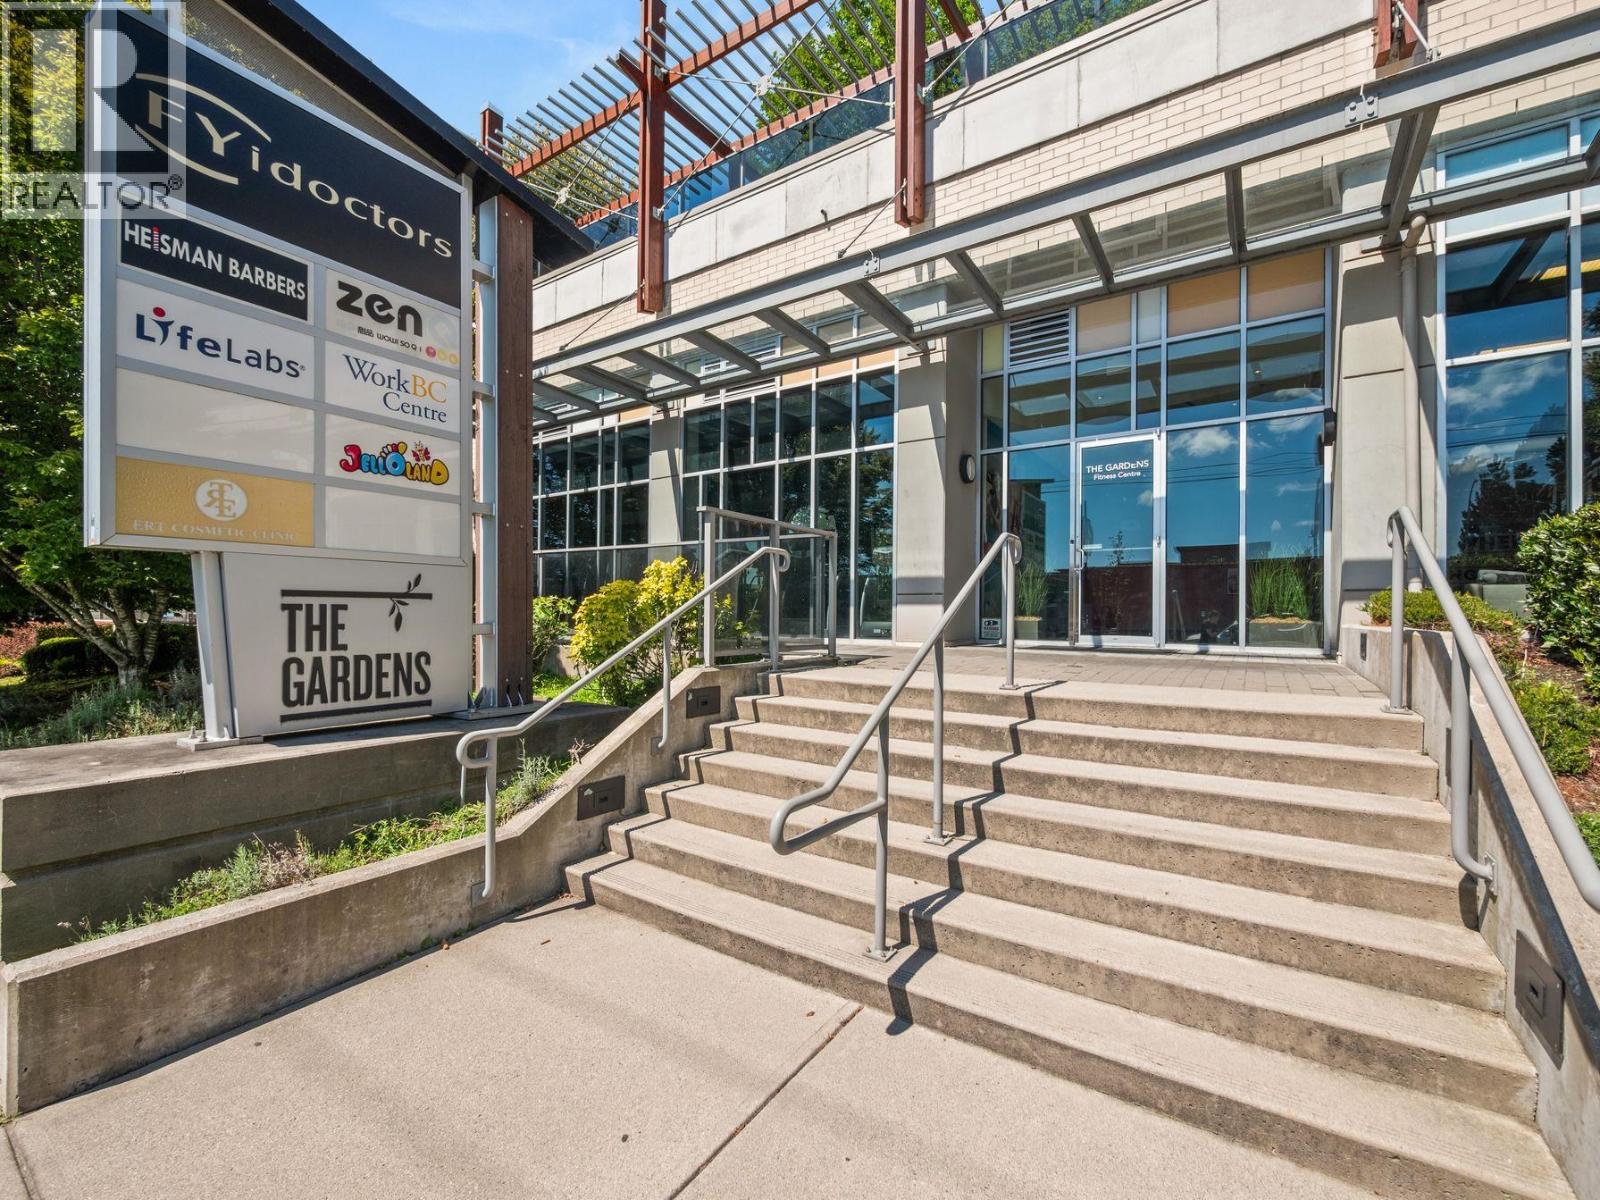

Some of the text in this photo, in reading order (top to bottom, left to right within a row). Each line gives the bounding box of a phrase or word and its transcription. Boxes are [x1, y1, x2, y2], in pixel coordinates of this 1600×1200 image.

[124, 220, 306, 301] HEISMAN BARBERS
[383, 391, 447, 424] Centre
[1086, 464, 1104, 473] THE
[281, 603, 348, 652] THE
[282, 651, 431, 708] GARDENS
